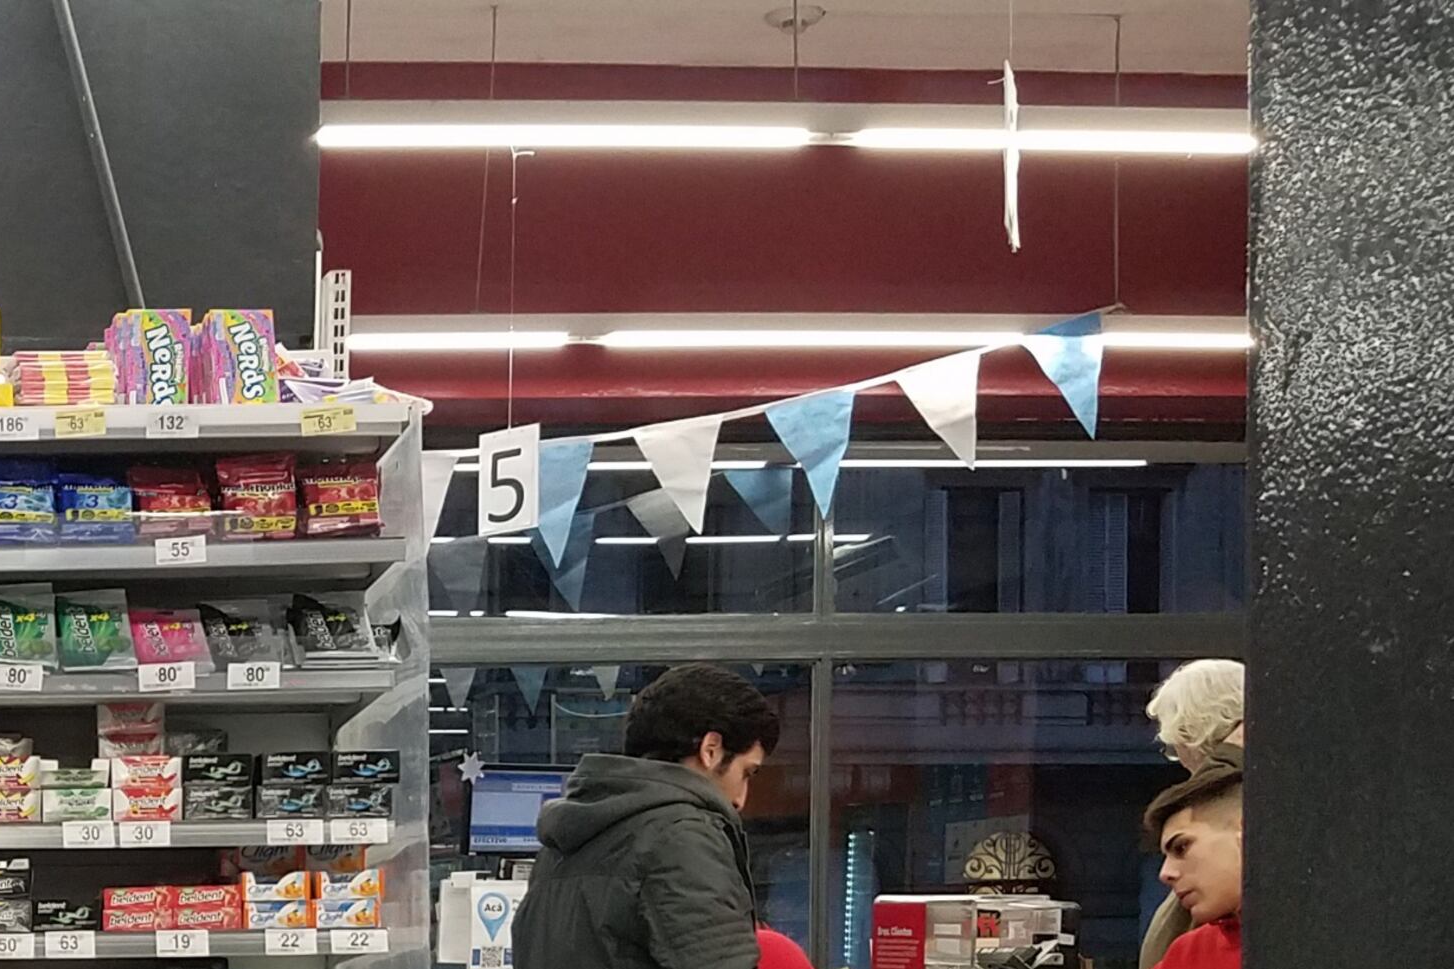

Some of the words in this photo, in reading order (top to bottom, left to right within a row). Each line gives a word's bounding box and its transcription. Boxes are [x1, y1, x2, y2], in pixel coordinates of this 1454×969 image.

[228, 321, 265, 400] Nerds
[158, 416, 184, 430] 132
[488, 448, 524, 523] 5
[484, 903, 502, 912] Acá
